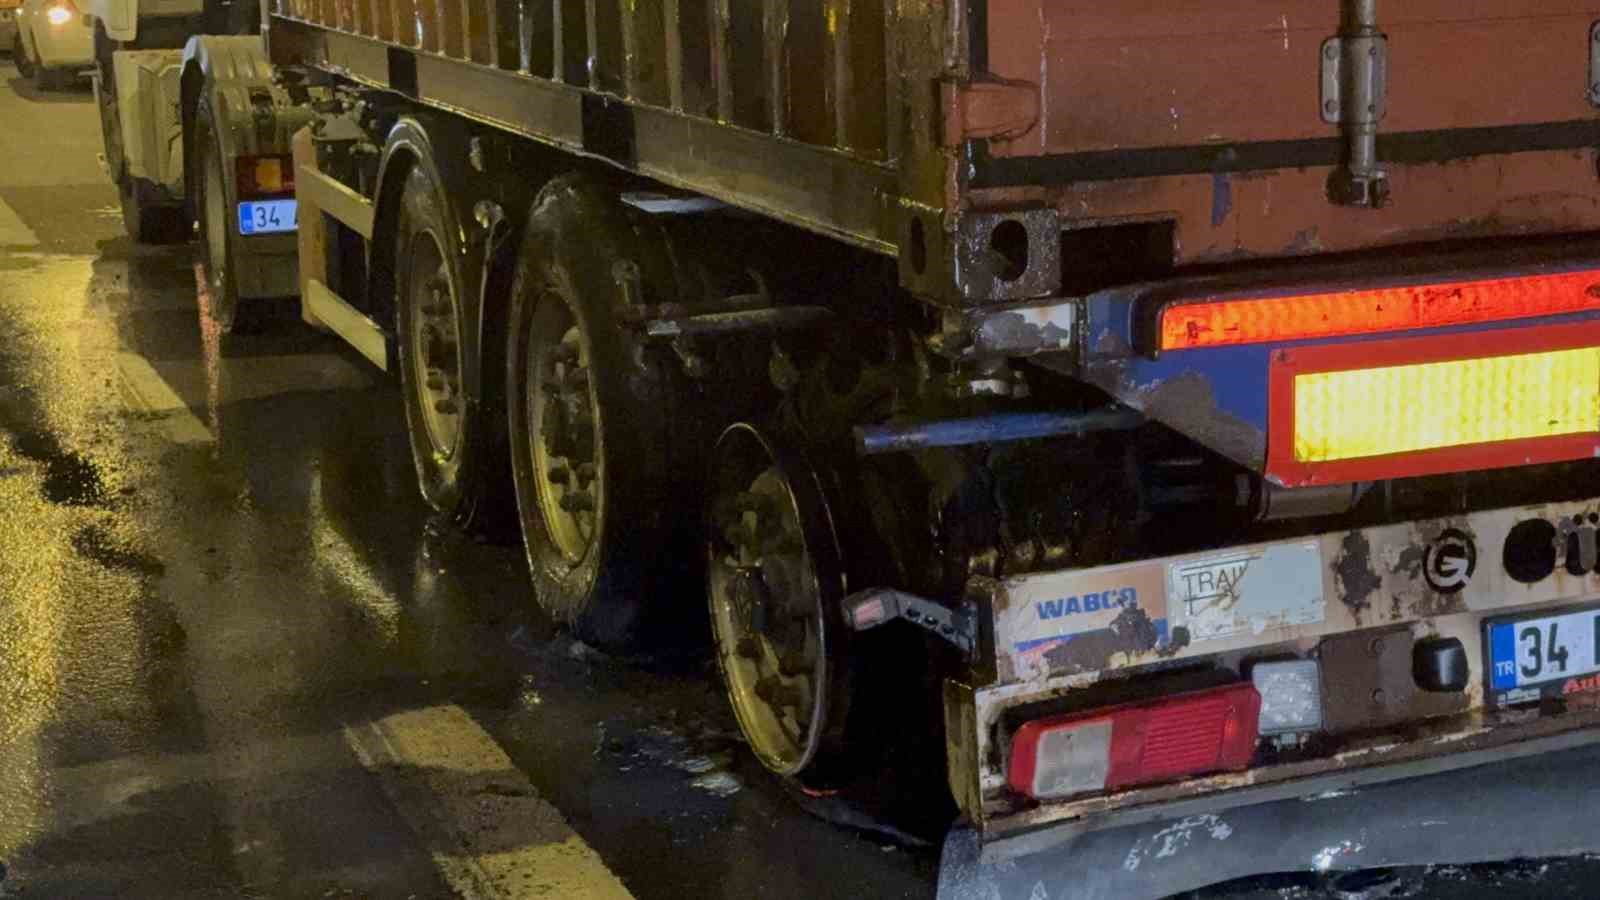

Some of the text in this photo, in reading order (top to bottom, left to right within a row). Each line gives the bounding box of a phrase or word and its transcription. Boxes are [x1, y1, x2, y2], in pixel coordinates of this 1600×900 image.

[256, 206, 280, 227] 34
[1495, 661, 1514, 677] TR
[1520, 623, 1568, 678] 34
